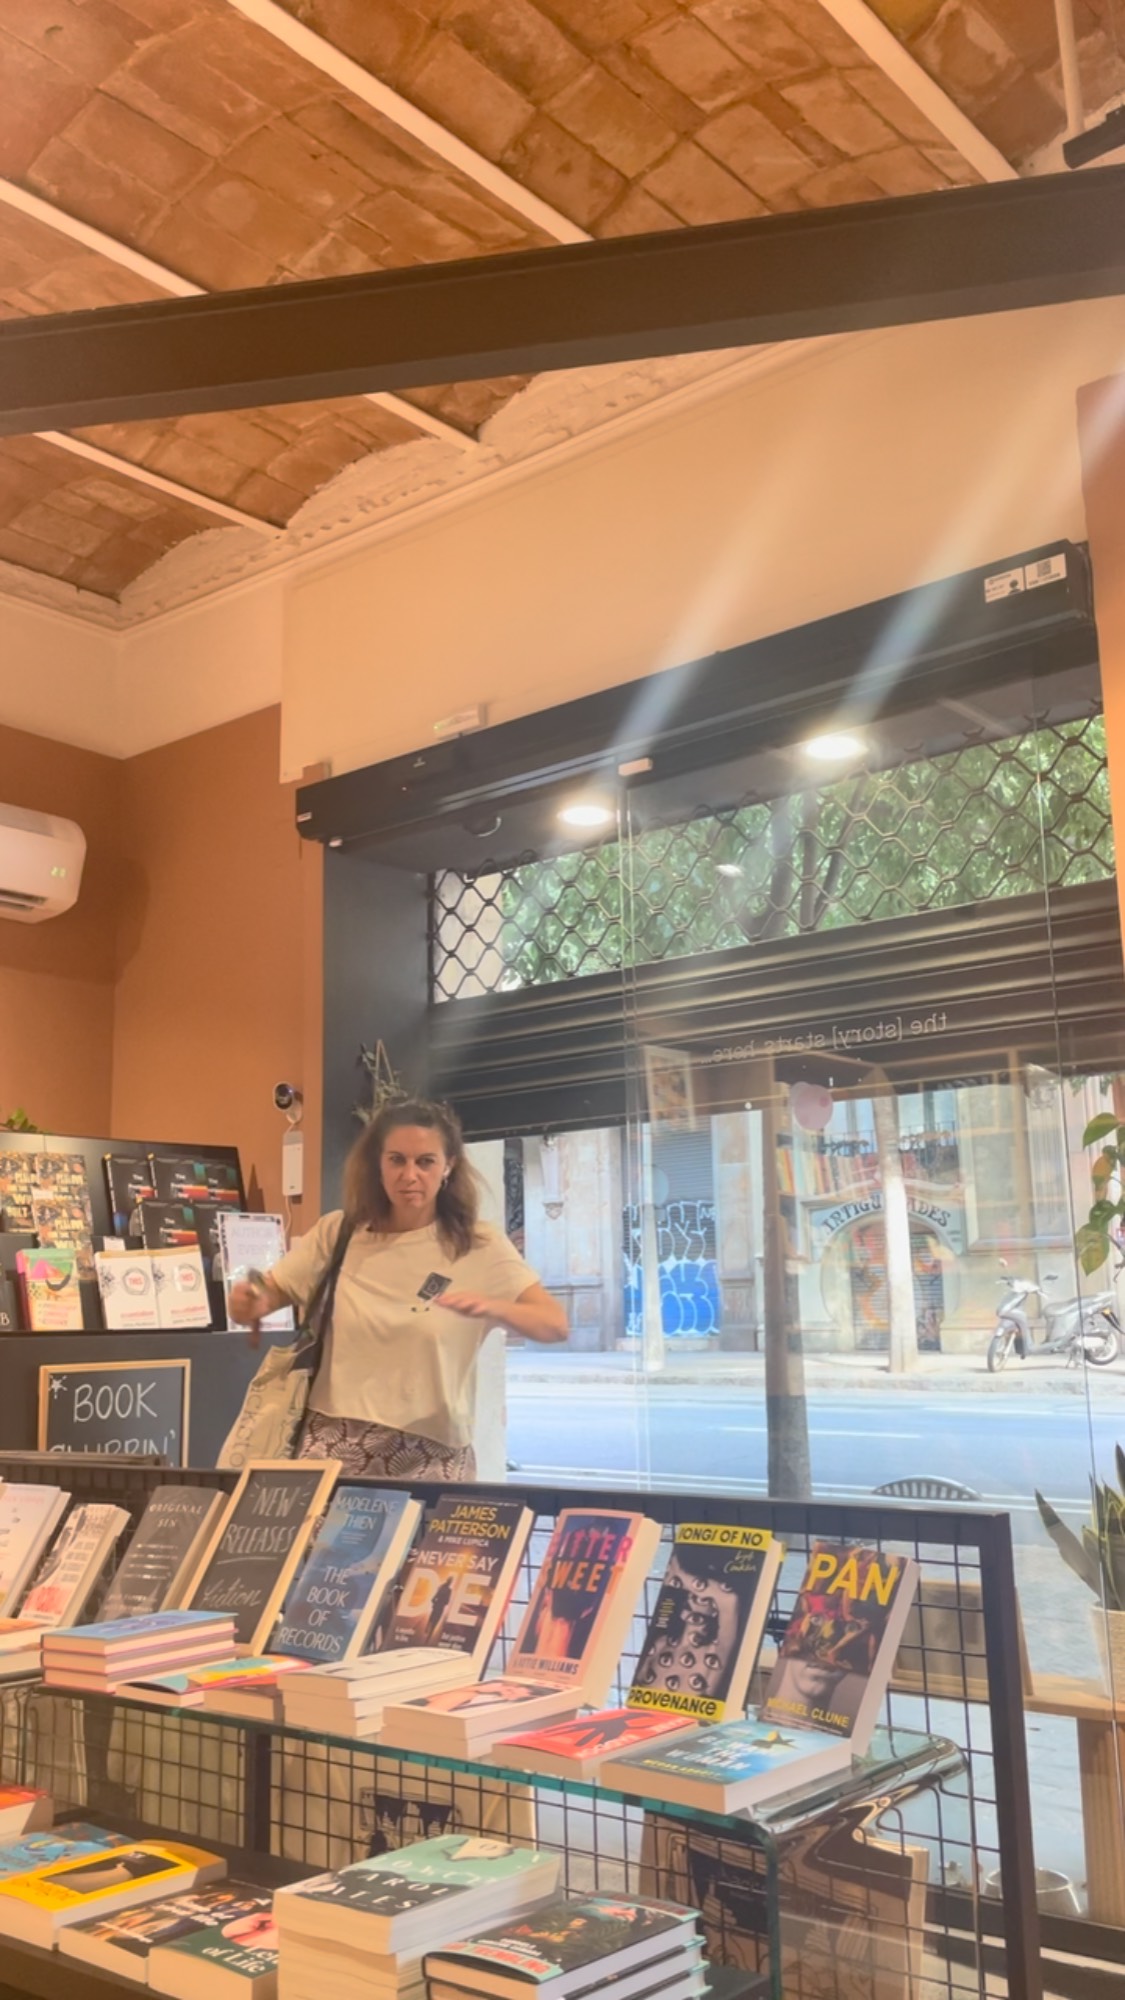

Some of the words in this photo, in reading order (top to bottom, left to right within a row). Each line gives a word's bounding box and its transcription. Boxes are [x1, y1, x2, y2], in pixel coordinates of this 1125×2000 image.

[73, 1382, 158, 1423] BOOK
[252, 1487, 301, 1517] NEW
[450, 1505, 498, 1521] JAMES
[220, 1523, 297, 1554] RELEASES
[428, 1518, 511, 1540] PATTERSON
[719, 1530, 738, 1545] OF
[740, 1532, 764, 1547] NO
[417, 1549, 468, 1568] NEVER
[468, 1554, 499, 1572] SAY
[323, 1565, 351, 1586] THE
[805, 1552, 899, 1606] PAN
[306, 1586, 351, 1608] BOOK
[307, 1608, 332, 1628] OF
[278, 1626, 344, 1654] RECORDS
[811, 1707, 851, 1728] CLUNE
[201, 1945, 235, 1957] of
[223, 1952, 266, 1973] Life
